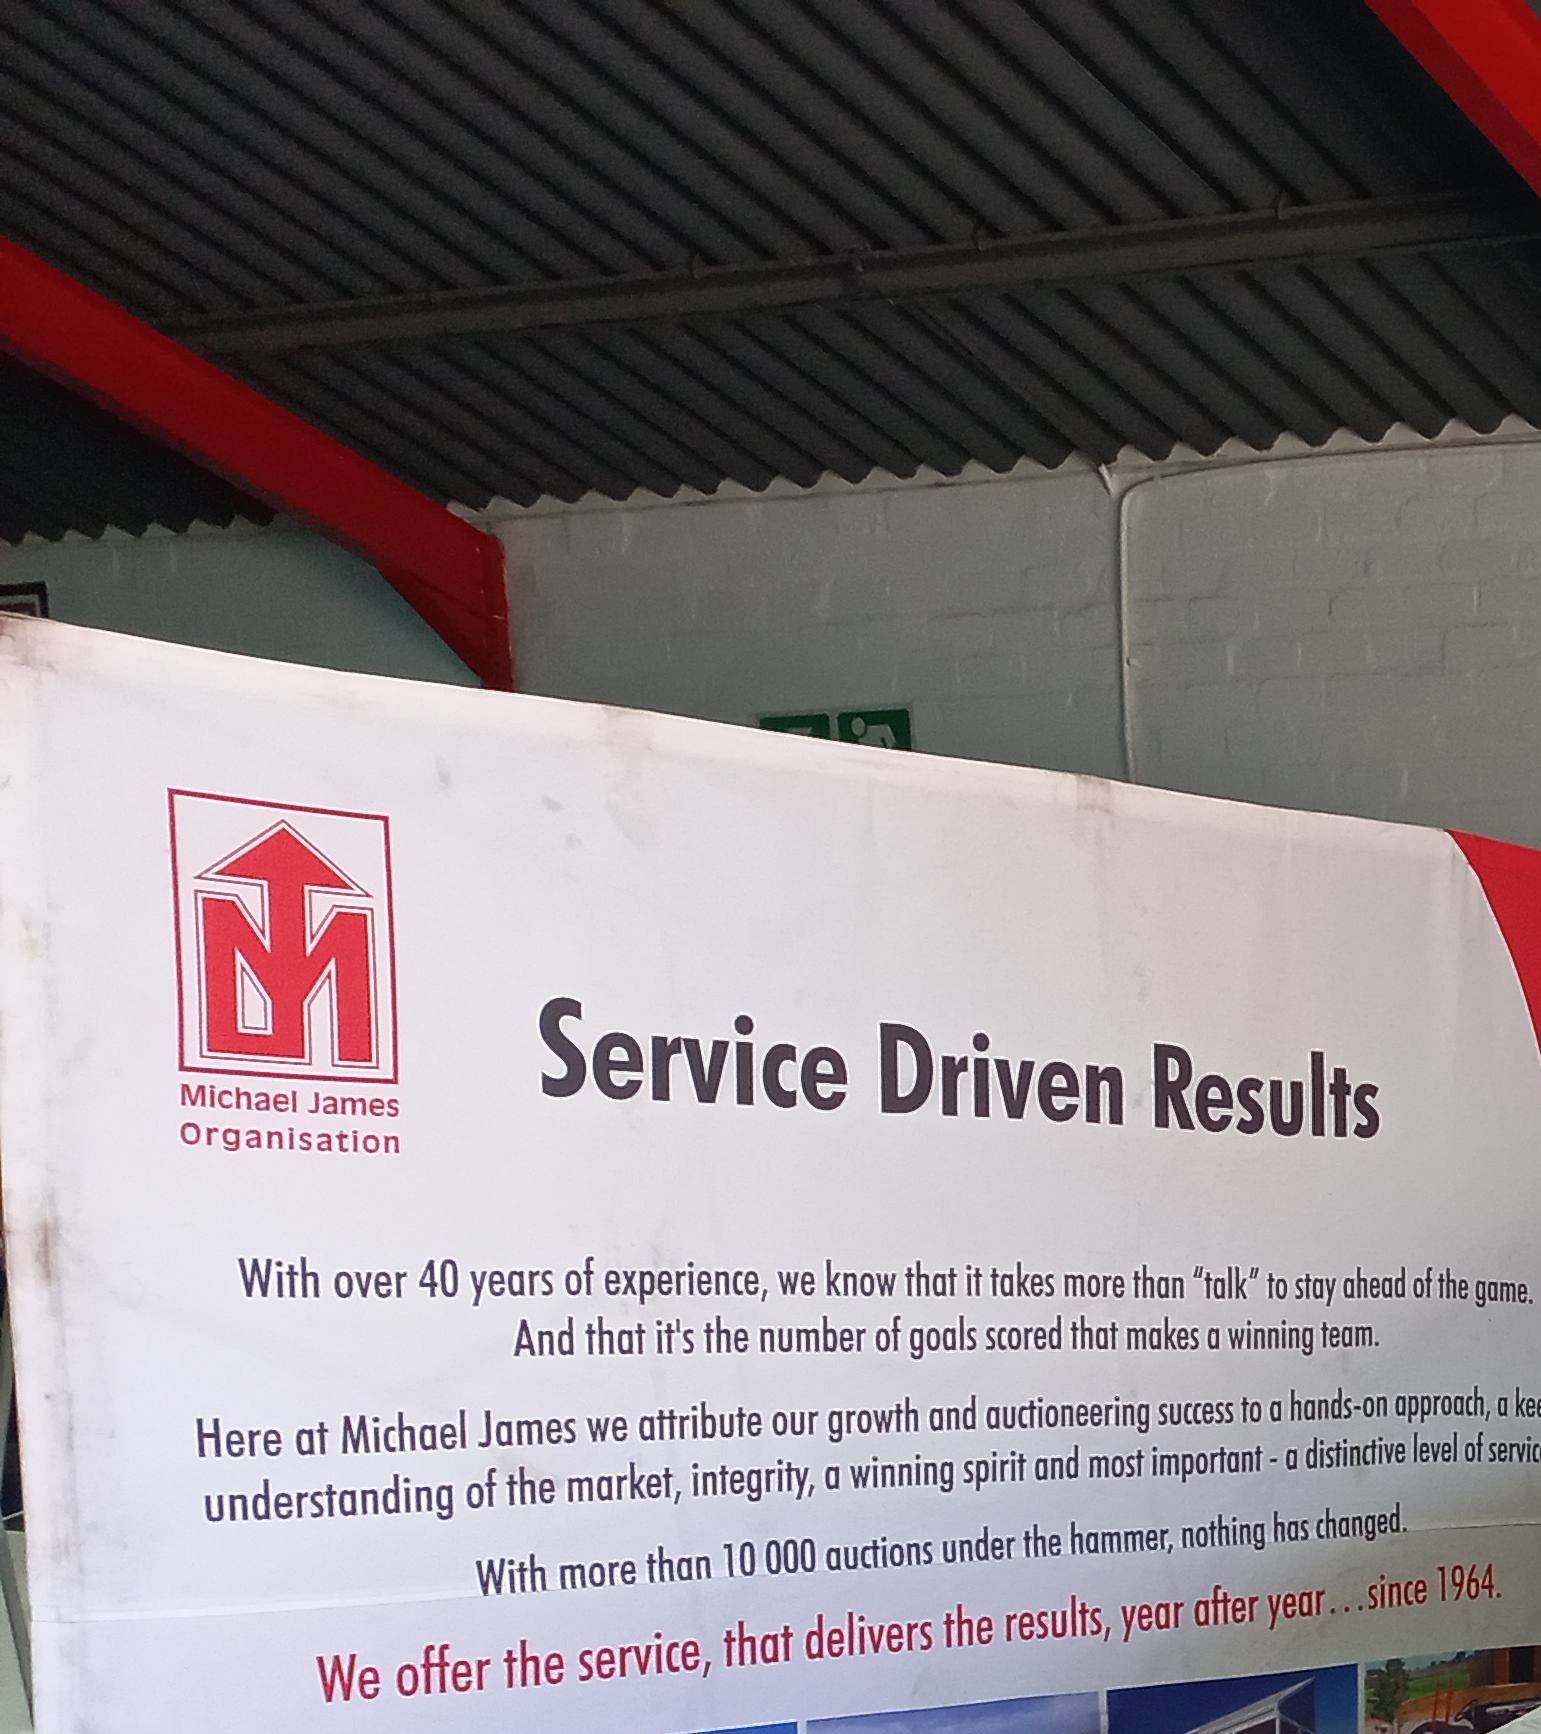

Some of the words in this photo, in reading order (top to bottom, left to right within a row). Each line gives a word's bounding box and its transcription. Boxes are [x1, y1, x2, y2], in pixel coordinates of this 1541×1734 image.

[181, 1084, 297, 1112] Michael
[308, 1092, 399, 1117] James
[540, 997, 847, 1110] Service
[880, 1023, 1123, 1125] Driven
[1154, 1043, 1379, 1138] Results
[181, 1123, 399, 1153] Organisation
[238, 1257, 319, 1298] With
[335, 1272, 407, 1298] over
[419, 1259, 458, 1297] 40
[470, 1270, 553, 1306] years
[605, 1262, 767, 1305] experience,
[778, 1272, 815, 1296] we
[826, 1259, 896, 1296] know
[905, 1261, 957, 1296] that
[990, 1262, 1054, 1297] takes
[1064, 1275, 1124, 1298] more
[1133, 1265, 1184, 1298] than
[1295, 1274, 1336, 1306] stay
[1344, 1266, 1405, 1298] ahead
[1438, 1268, 1468, 1299] the
[1475, 1280, 1533, 1307] game.
[514, 1317, 574, 1356] And
[585, 1316, 645, 1354] that
[656, 1319, 694, 1354] it's
[704, 1316, 748, 1353] the
[760, 1316, 866, 1352] number
[910, 1316, 976, 1359] goals
[986, 1315, 1061, 1350] scored
[1071, 1315, 1118, 1349] that
[1127, 1316, 1199, 1350] makes
[1228, 1320, 1313, 1356] winning
[1321, 1322, 1379, 1348] team.
[196, 1418, 282, 1457] Here
[342, 1409, 466, 1454] Michael
[478, 1410, 576, 1447] James
[587, 1417, 627, 1442] we
[639, 1401, 762, 1441] attribute
[773, 1412, 818, 1436] our
[829, 1397, 918, 1443] growth
[930, 1395, 976, 1431] and
[987, 1396, 1149, 1433] auctioneering
[1158, 1402, 1234, 1425] success
[1291, 1388, 1387, 1421] hands-on
[1396, 1386, 1490, 1423] approach,
[205, 1474, 453, 1522] understanding
[506, 1466, 555, 1505] the
[568, 1462, 681, 1504] market,
[692, 1462, 814, 1502] integrity,
[850, 1454, 953, 1492] winning
[964, 1451, 1026, 1491] spirit
[1035, 1445, 1078, 1480] and
[1090, 1450, 1144, 1478] most
[1153, 1446, 1263, 1483] important
[1306, 1437, 1406, 1469] distinctive
[1414, 1432, 1457, 1462] level
[476, 1554, 547, 1596] With
[560, 1561, 636, 1589] more
[647, 1546, 711, 1583] than
[724, 1542, 755, 1577] 10
[766, 1539, 815, 1574] 000
[826, 1537, 933, 1570] auctions
[943, 1526, 1015, 1563] under
[1023, 1524, 1061, 1557] the
[1071, 1522, 1173, 1554] hammer,
[1182, 1514, 1265, 1550] nothing
[1274, 1511, 1309, 1542] has
[1316, 1502, 1407, 1541] changed.
[316, 1654, 380, 1702] We
[397, 1644, 490, 1696] offer
[504, 1640, 564, 1688] the
[579, 1632, 711, 1681] service,
[724, 1621, 793, 1666] that
[806, 1612, 932, 1659] delivers
[943, 1604, 993, 1647] the
[1006, 1595, 1110, 1642] results,
[1122, 1602, 1184, 1642] year
[1194, 1585, 1259, 1626] after
[1438, 1564, 1501, 1601] 1964.
